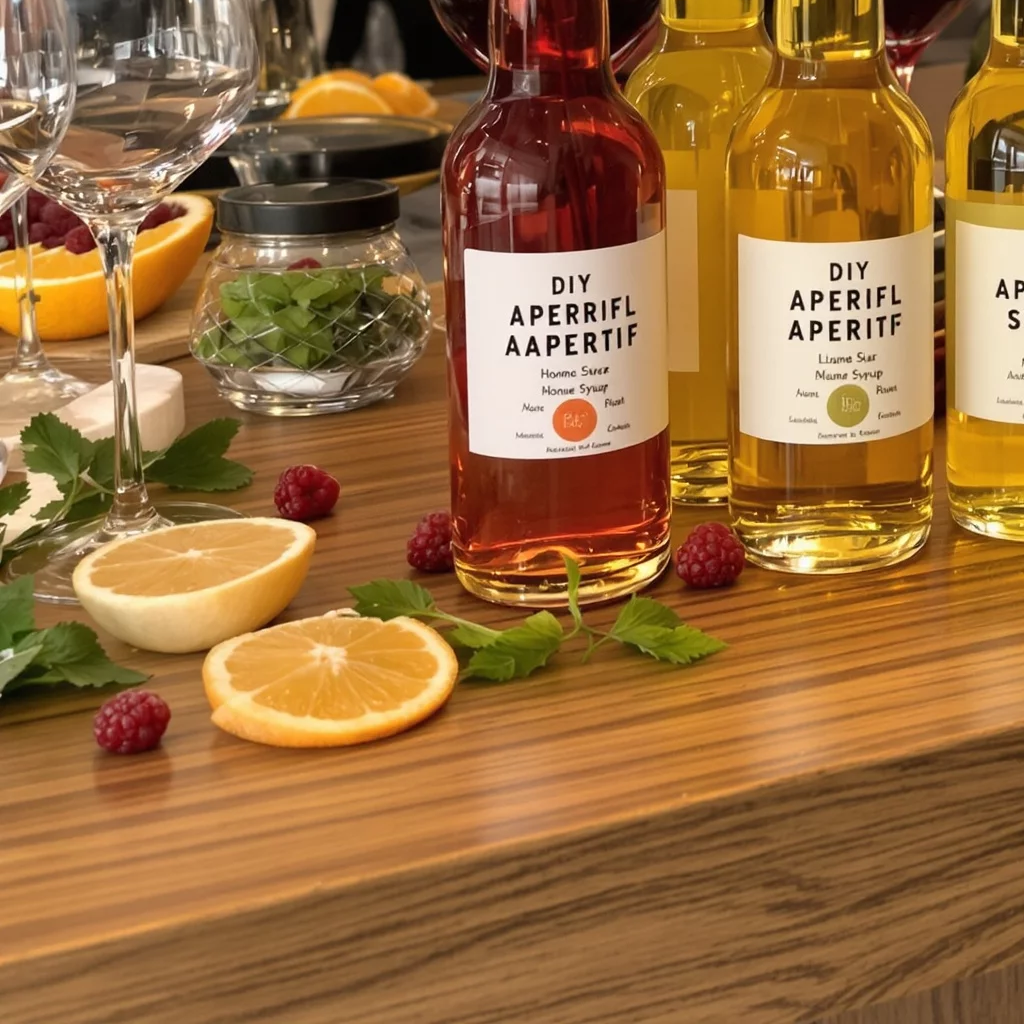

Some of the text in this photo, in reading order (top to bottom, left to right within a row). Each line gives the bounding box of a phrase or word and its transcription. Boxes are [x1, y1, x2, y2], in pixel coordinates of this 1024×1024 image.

[552, 274, 592, 295] DIY
[829, 261, 870, 282] DIY
[510, 295, 636, 326] APERRIFL
[790, 284, 902, 312] APERIFL
[505, 323, 638, 356] AAPERTIF
[788, 313, 902, 342] APERITF
